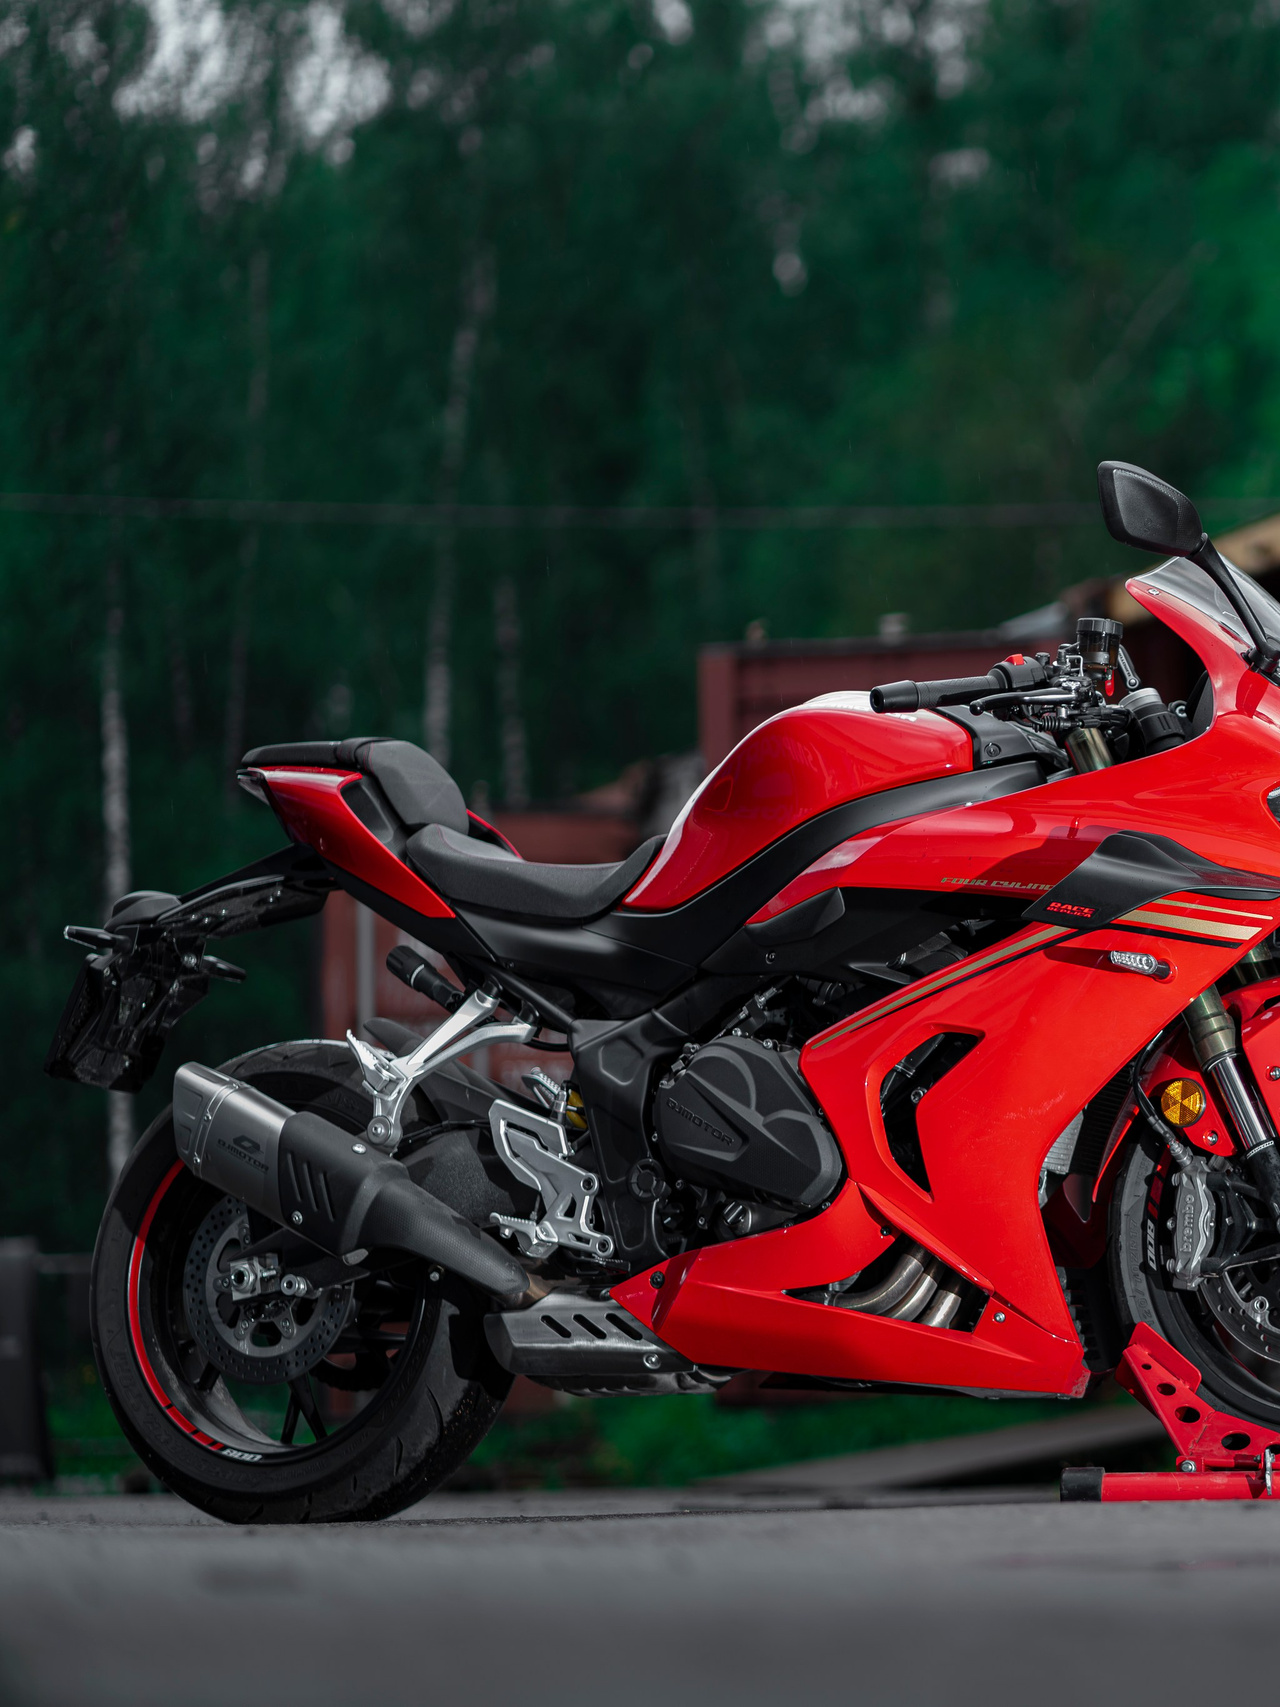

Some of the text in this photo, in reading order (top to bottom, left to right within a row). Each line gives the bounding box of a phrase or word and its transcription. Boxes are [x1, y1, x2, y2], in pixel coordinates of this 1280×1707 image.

[940, 877, 988, 887] FOUR
[1046, 906, 1092, 918] REPLICA
[1049, 901, 1096, 915] RACE
[1179, 1194, 1195, 1253] brembo
[1147, 1218, 1158, 1272] 800
[222, 1448, 263, 1462] 800
